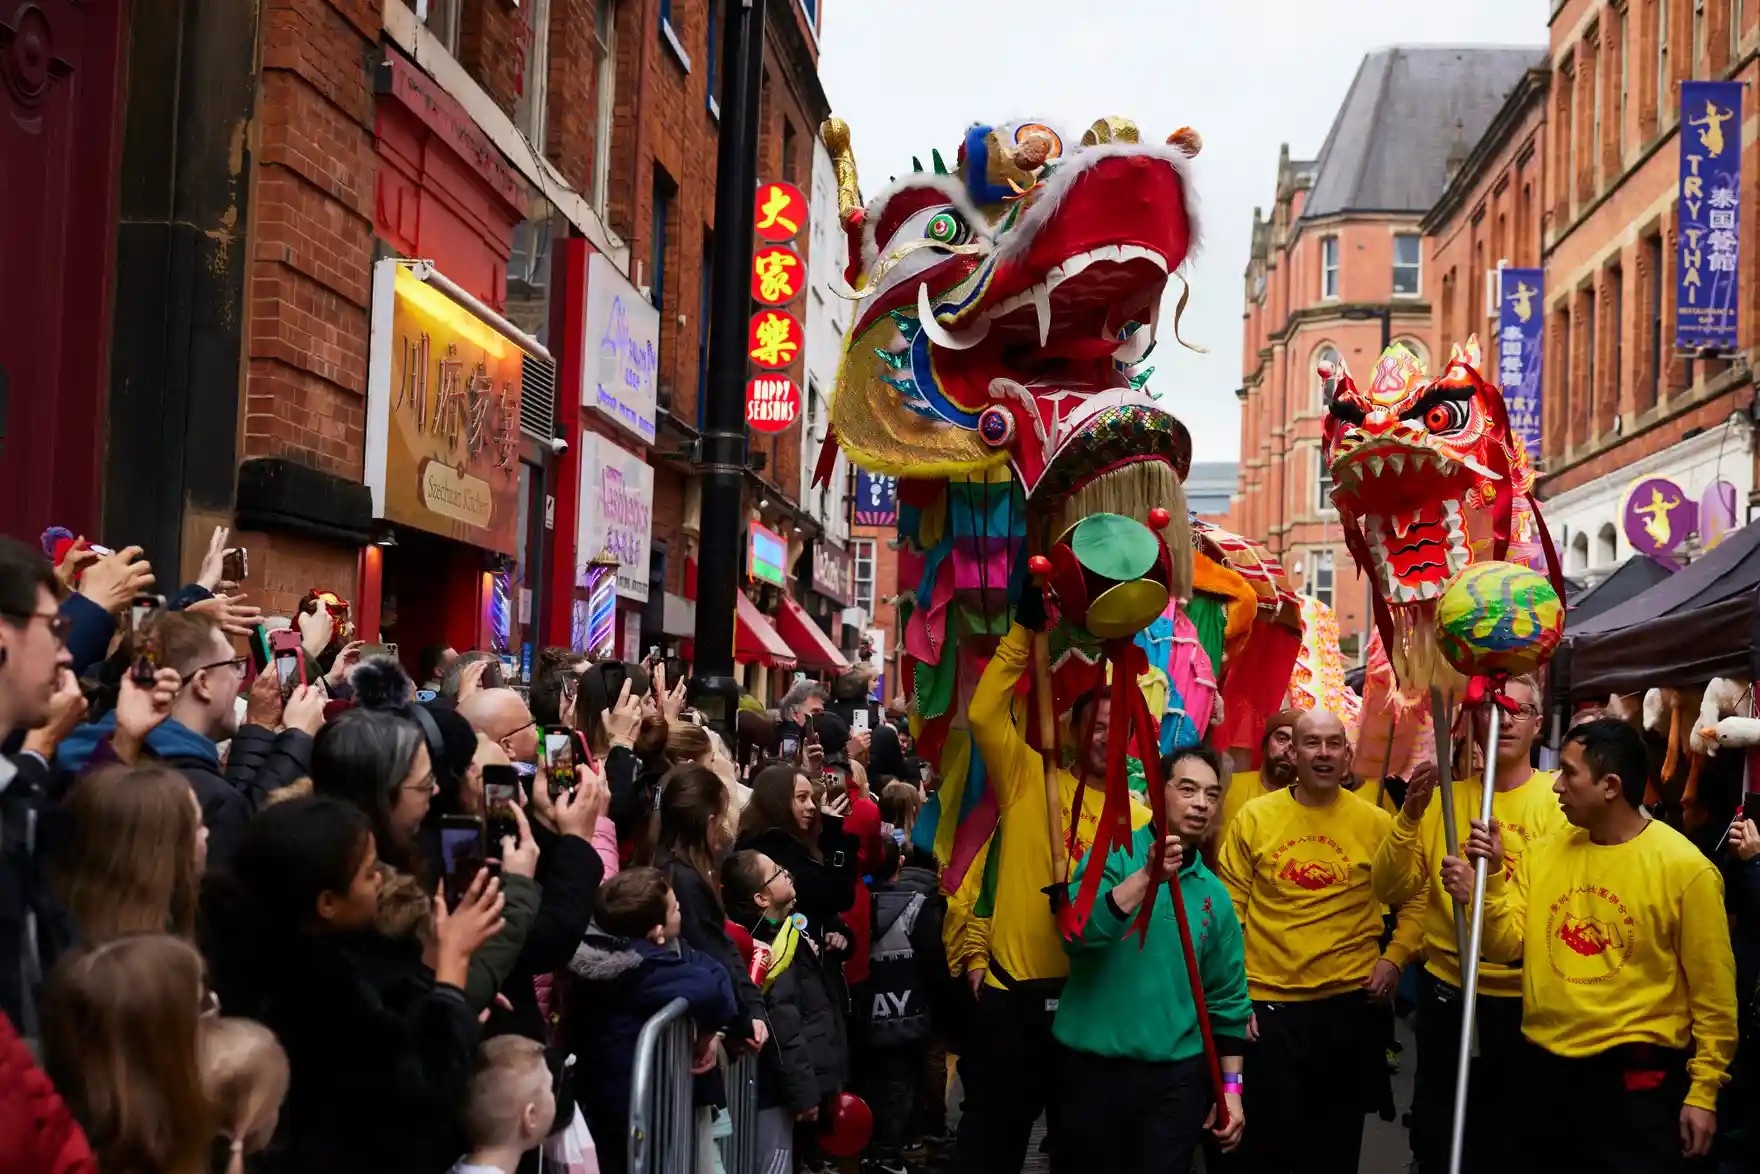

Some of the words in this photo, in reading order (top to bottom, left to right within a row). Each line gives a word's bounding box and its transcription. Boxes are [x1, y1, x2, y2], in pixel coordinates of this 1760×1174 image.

[1684, 154, 1703, 221] TRY
[751, 185, 798, 365] 大家樂
[1683, 228, 1702, 305] THAI
[748, 400, 794, 421] SEASONS
[753, 379, 790, 400] HAPPY
[1509, 413, 1539, 427] HAI
